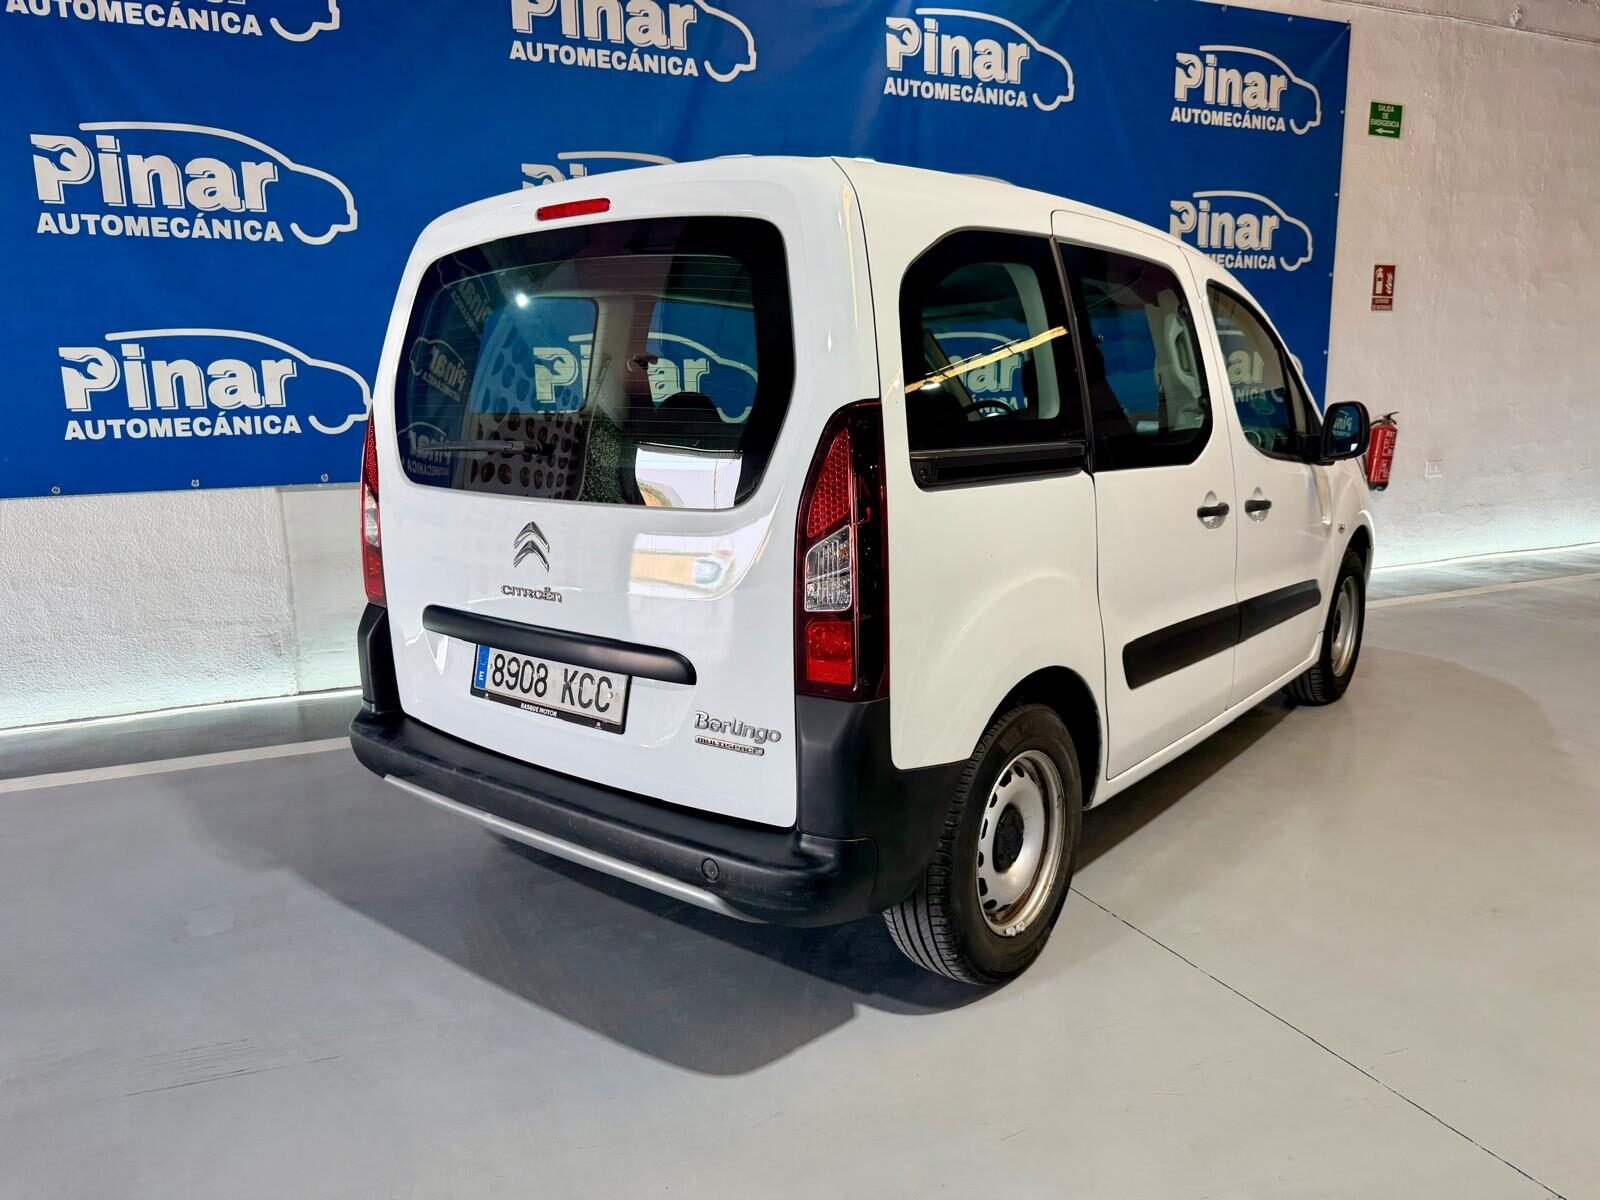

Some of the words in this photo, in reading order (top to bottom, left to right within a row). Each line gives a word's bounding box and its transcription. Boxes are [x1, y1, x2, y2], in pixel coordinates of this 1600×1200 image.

[5, 0, 263, 36] AUTOMECÁNICA
[510, 0, 697, 50] Pinar
[509, 40, 699, 77] AUTOMECÁNICA
[885, 16, 1030, 84] Pinar
[883, 76, 1028, 107] AUTOMECÁNICA
[1173, 52, 1287, 112] Pinar
[1170, 107, 1286, 132] AUTOMECÁNICA
[30, 133, 278, 213] Pinar
[37, 213, 283, 242] AUTOMECÁNICA
[1169, 199, 1280, 251] Pinar
[58, 344, 297, 412] Pinar
[533, 346, 710, 404] Piar
[64, 412, 302, 440] AUTOMECÁNICA
[501, 585, 563, 603] CITROËN
[478, 671, 485, 681] E
[491, 653, 549, 698] 8908
[561, 668, 613, 713] KCC
[520, 702, 539, 713] BASQUE
[538, 706, 557, 718] MOTOR
[694, 710, 782, 745] Berlingo
